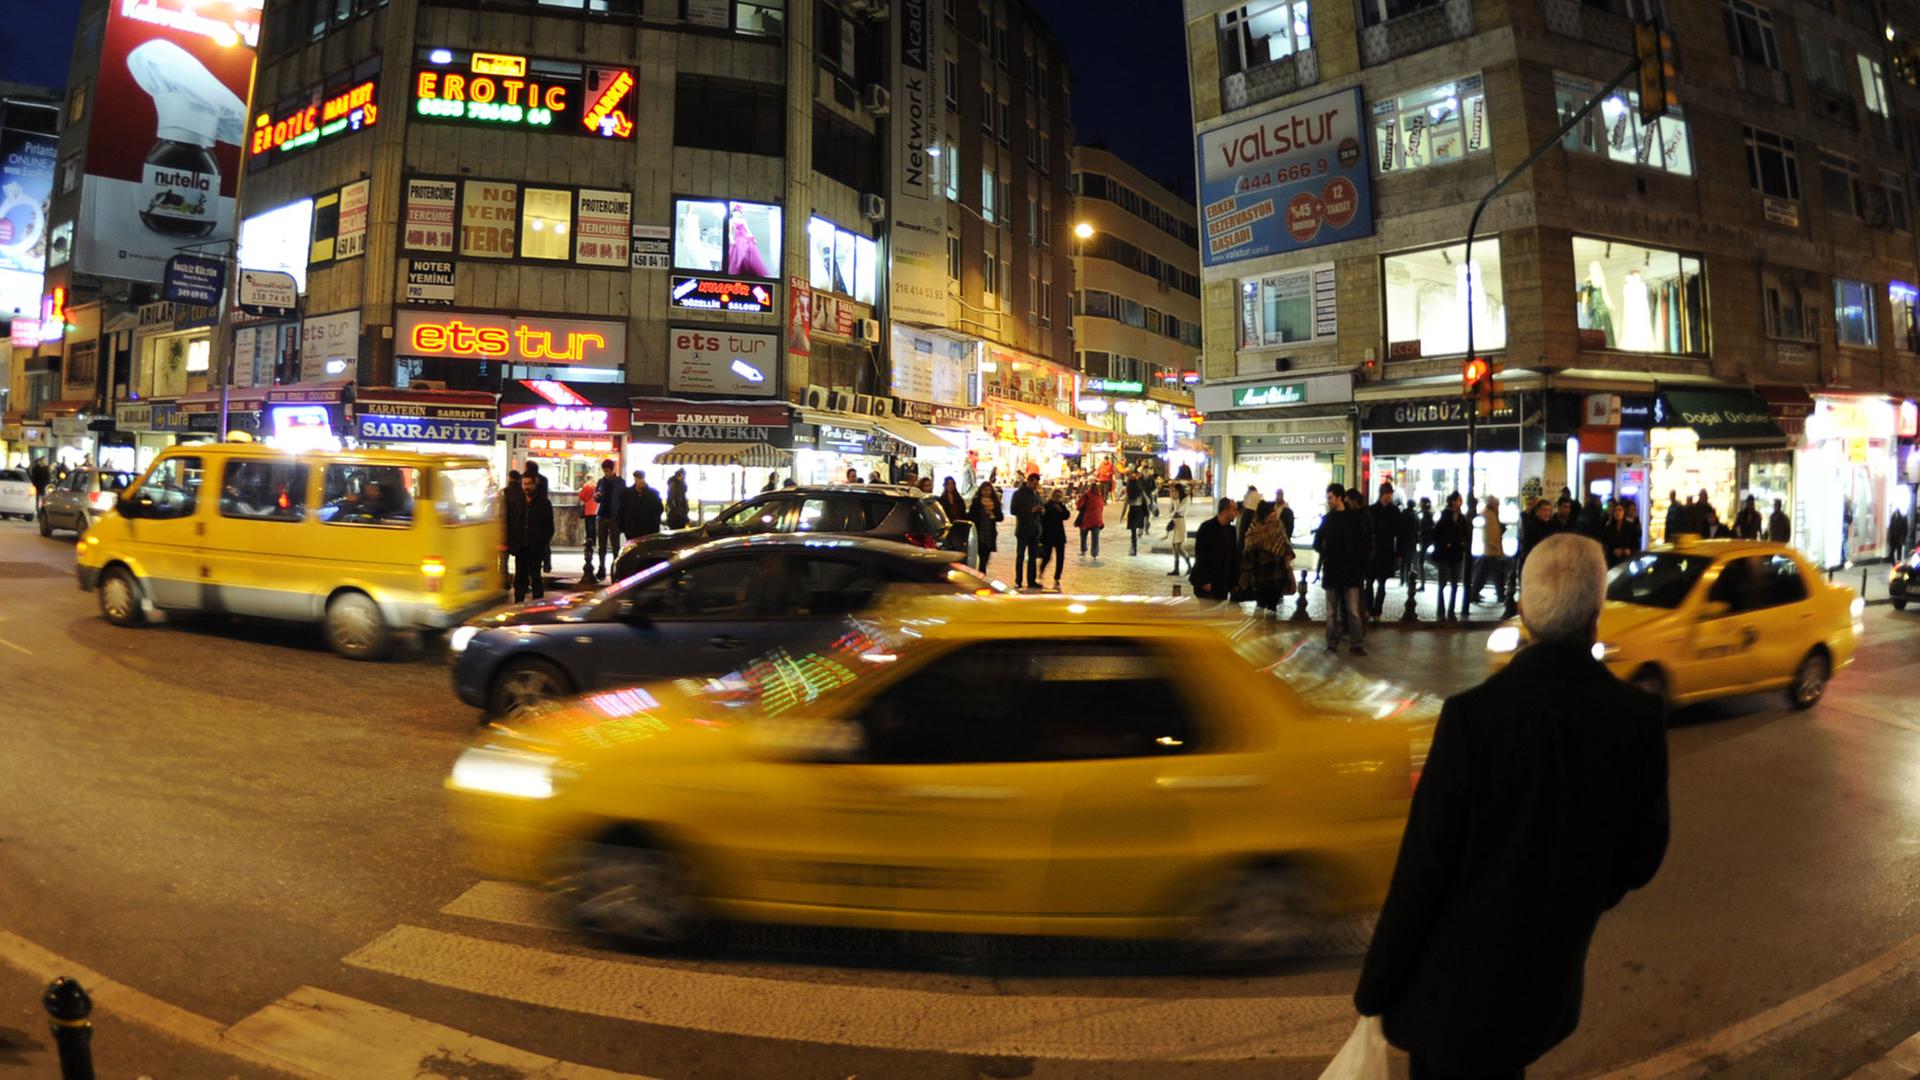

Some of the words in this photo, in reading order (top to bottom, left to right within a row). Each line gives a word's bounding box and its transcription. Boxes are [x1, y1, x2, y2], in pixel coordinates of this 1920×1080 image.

[418, 71, 567, 111] EROTIC
[583, 71, 634, 132] MARKET
[253, 107, 317, 154] EROTIC
[905, 77, 923, 187] Network
[1221, 108, 1338, 168] valstur
[154, 170, 210, 192] nutella
[1240, 171, 1272, 191] 444
[1277, 163, 1312, 184] 666
[1316, 158, 1329, 174] 9
[414, 261, 452, 272] NOTER
[410, 271, 455, 285] YEMİNLİ
[412, 321, 509, 356] ets
[514, 325, 605, 360] tur
[676, 333, 720, 352] ets
[728, 336, 766, 353] tur
[368, 404, 427, 416] KARATEKİN
[437, 409, 487, 419] SARRAFİYE
[676, 414, 750, 425] KARATEKİN
[1394, 401, 1461, 423] GÜRBÜZ
[362, 422, 491, 441] SARRAFİYE
[657, 424, 769, 441] KARATEKİN
